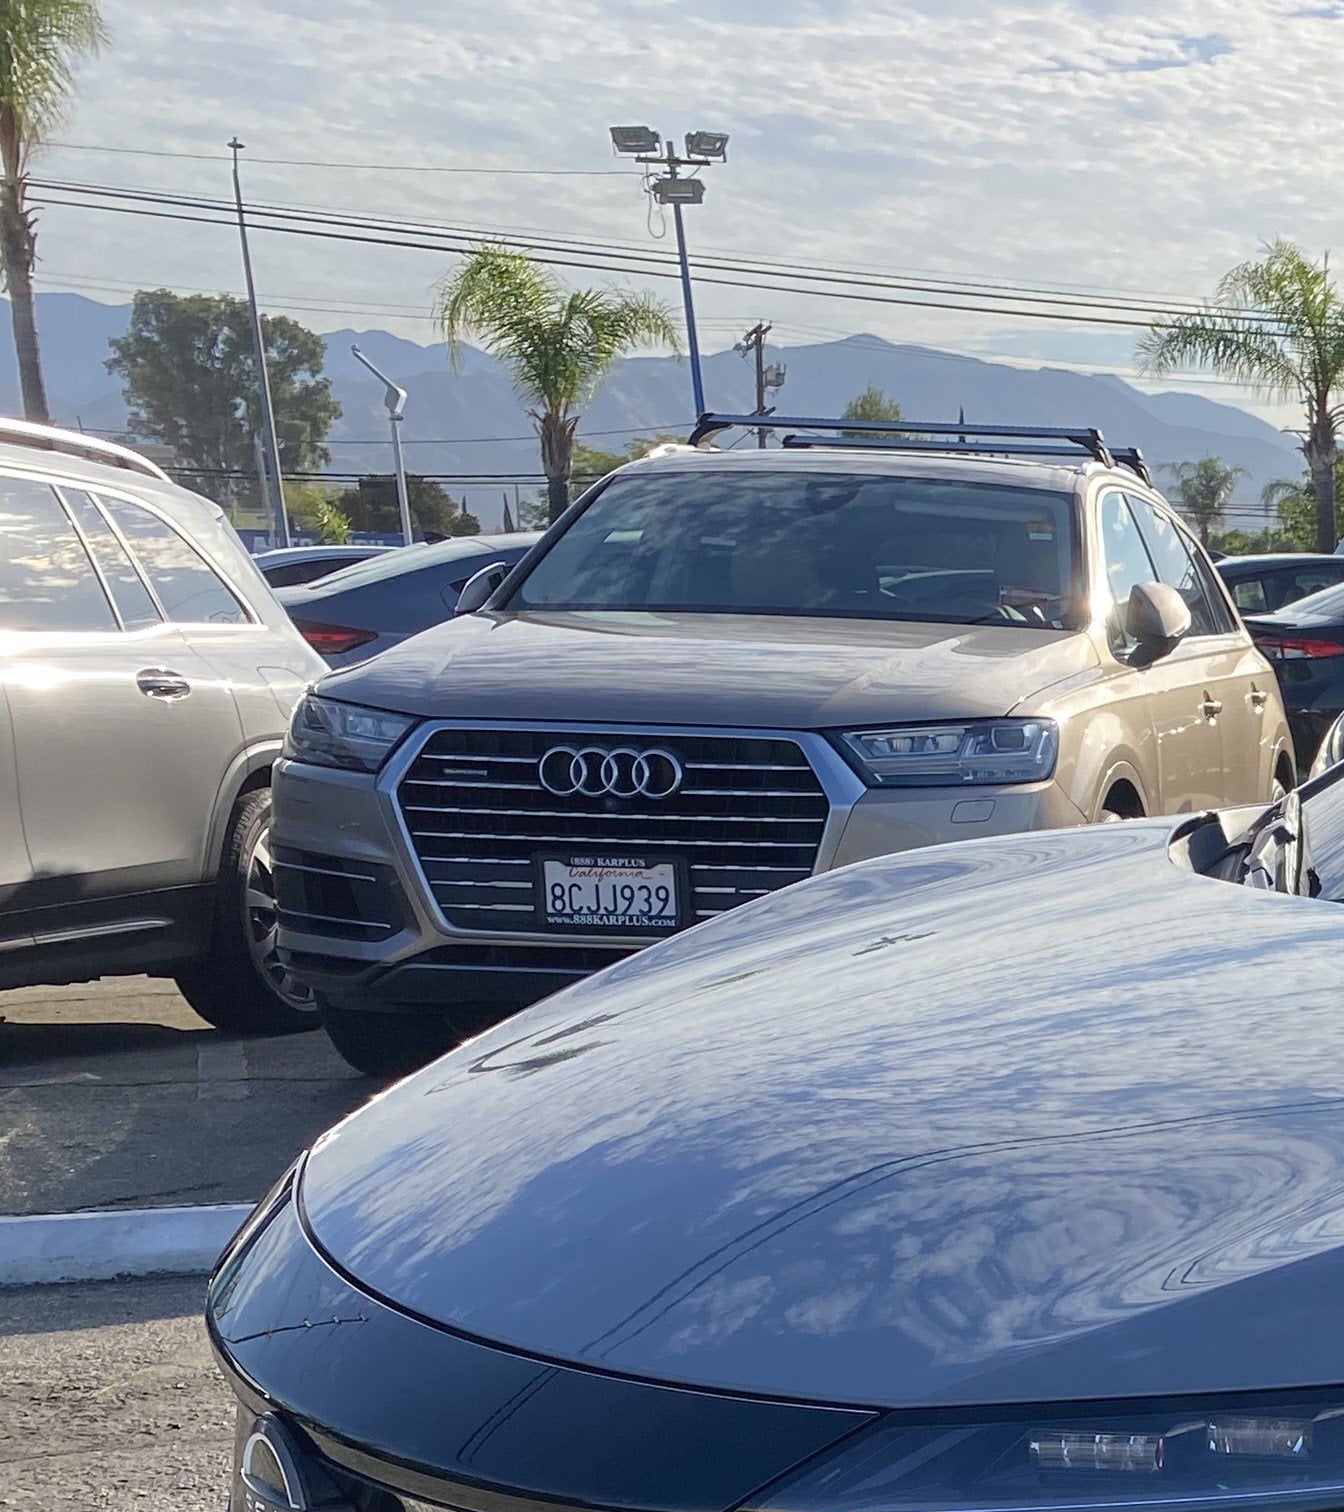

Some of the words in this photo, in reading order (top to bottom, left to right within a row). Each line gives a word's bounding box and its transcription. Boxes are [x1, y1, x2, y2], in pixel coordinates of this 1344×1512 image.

[597, 858, 646, 867] KARPLUS
[569, 867, 652, 882] California
[551, 882, 670, 916] 8CJJ939
